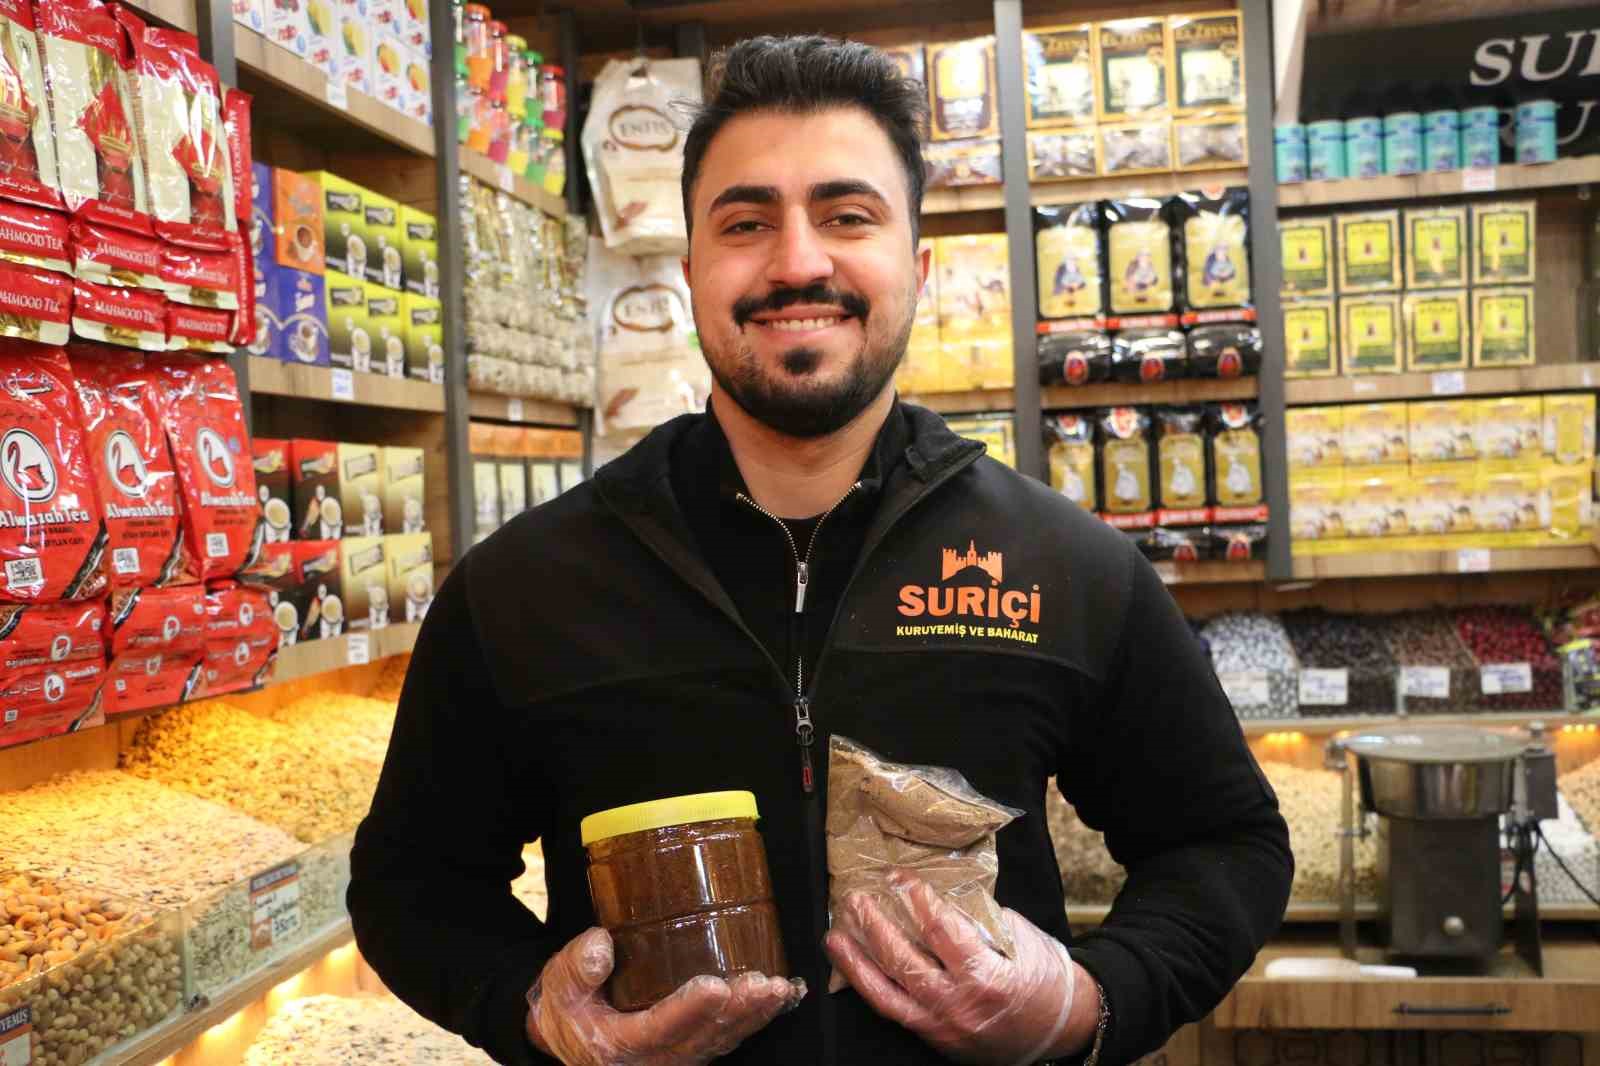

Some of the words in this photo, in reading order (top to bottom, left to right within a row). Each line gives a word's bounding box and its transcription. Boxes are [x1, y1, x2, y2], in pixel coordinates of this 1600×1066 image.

[897, 579, 1041, 628] SURİÇİ
[896, 623, 966, 637] KURUYEMİŞ
[969, 627, 985, 636] VE
[987, 627, 1038, 643] BAHARAT
